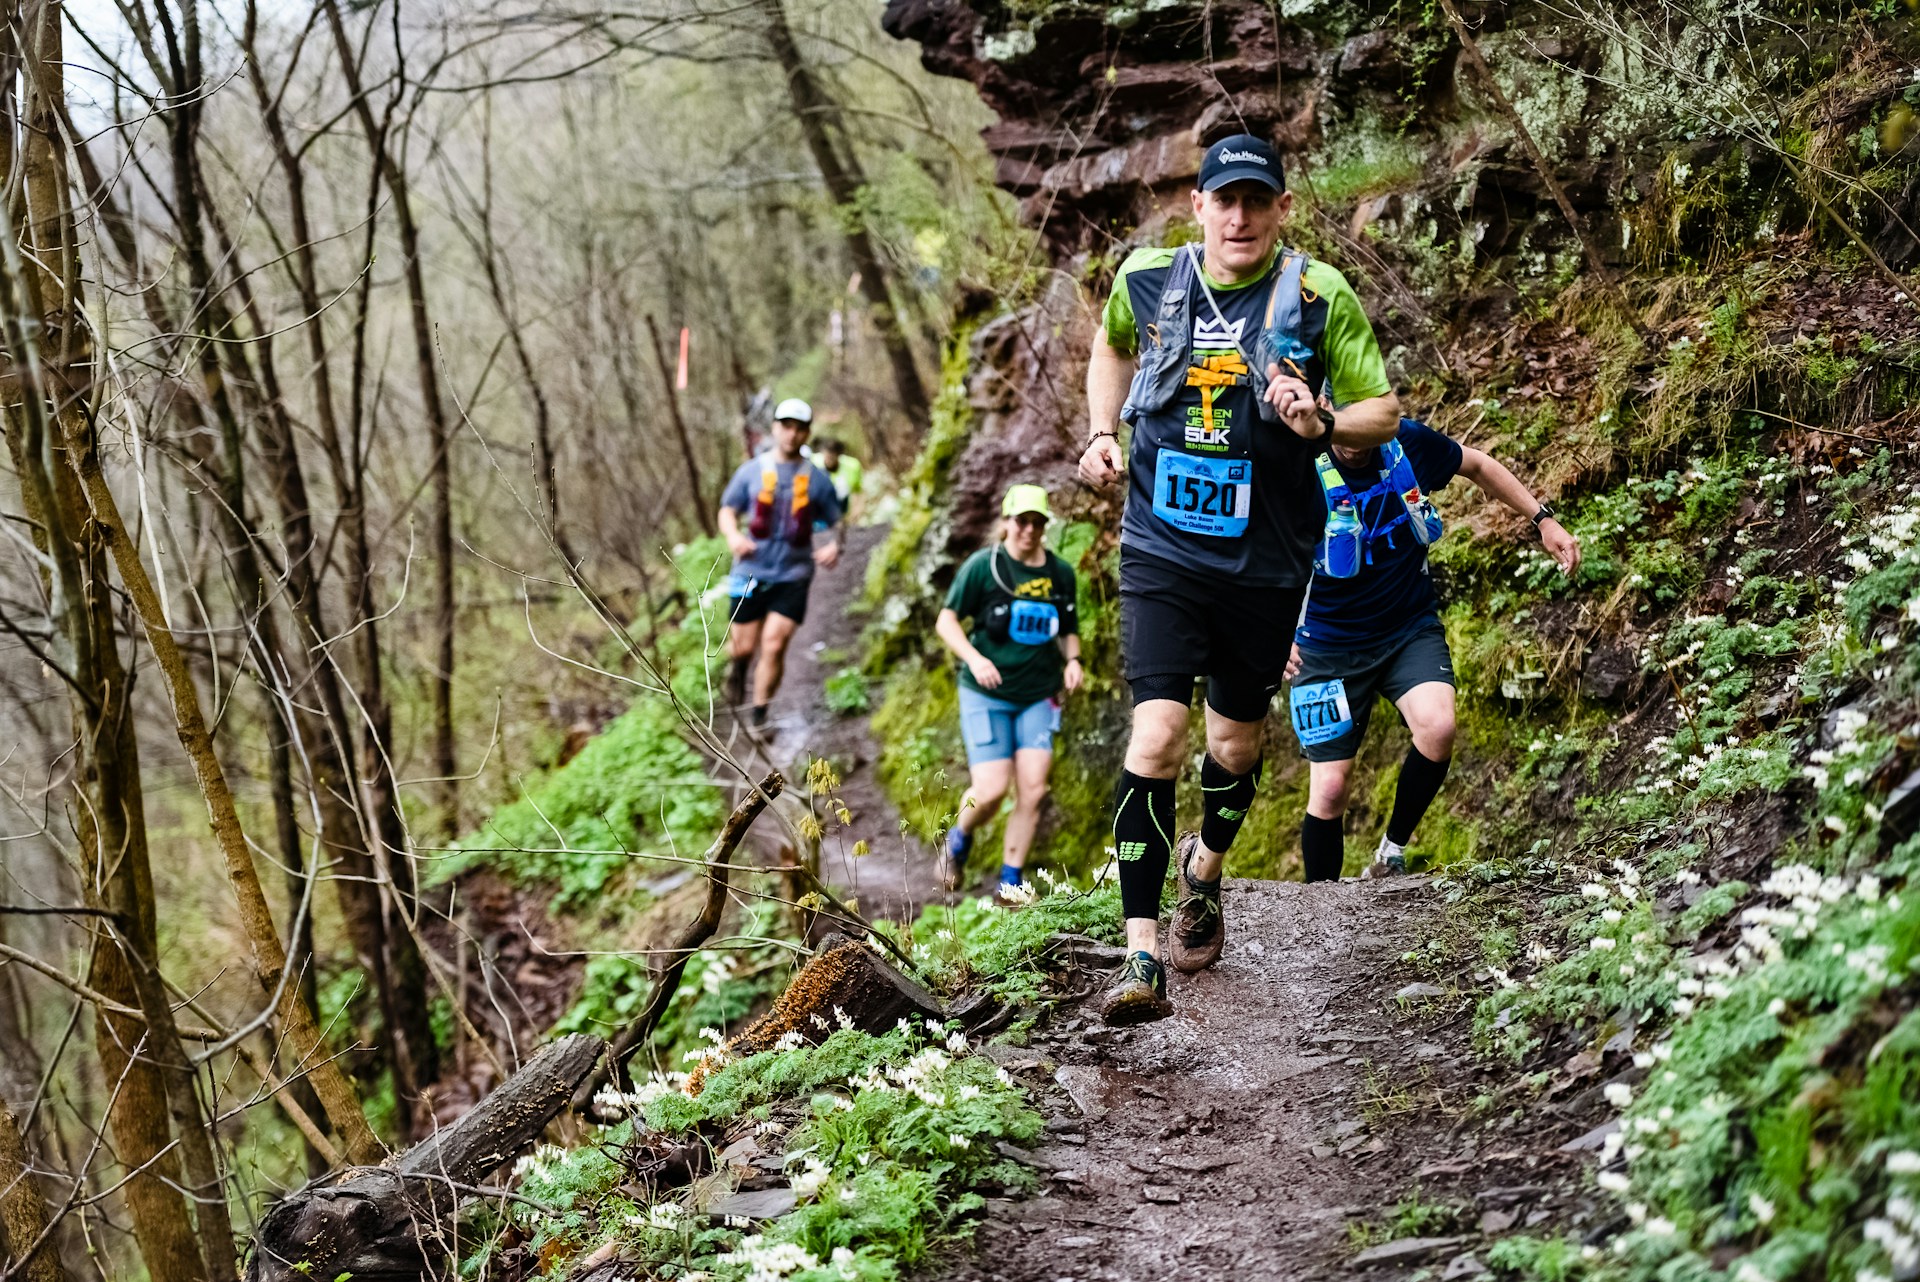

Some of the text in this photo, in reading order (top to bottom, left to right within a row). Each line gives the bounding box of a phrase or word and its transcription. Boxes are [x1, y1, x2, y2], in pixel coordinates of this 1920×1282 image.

[1187, 406, 1232, 418] GREN
[1185, 417, 1230, 428] JEEL
[1185, 426, 1230, 445] 50K
[1166, 474, 1236, 517] 1520
[1188, 521, 1213, 531] Challenge
[1295, 698, 1341, 731] 1770
